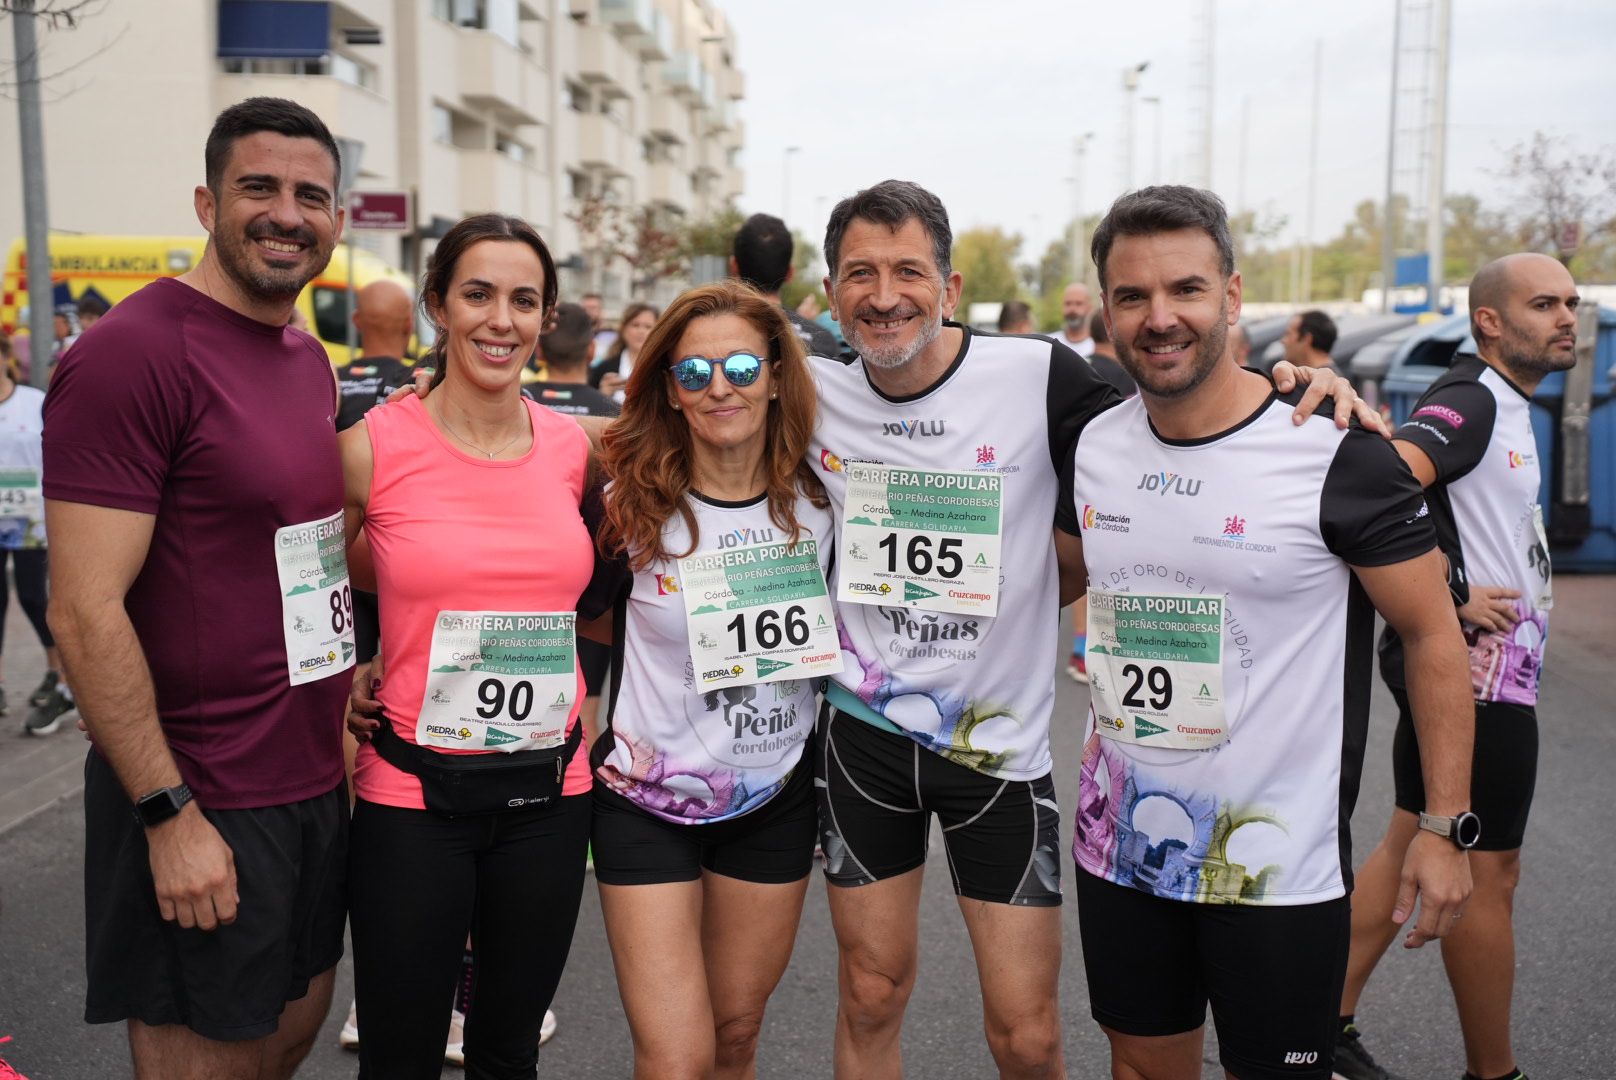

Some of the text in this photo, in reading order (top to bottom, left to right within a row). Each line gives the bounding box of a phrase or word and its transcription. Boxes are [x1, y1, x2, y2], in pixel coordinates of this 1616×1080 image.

[883, 419, 945, 440] JOYLU
[851, 468, 999, 492] CARRERA POPULAR
[1137, 471, 1201, 497] JOYLU
[905, 492, 935, 505] PEÑAS
[937, 496, 999, 508] CORDOBESAS
[862, 503, 902, 516] Córdoba
[910, 508, 944, 519] Medina
[947, 511, 987, 522] Azahara
[1095, 511, 1130, 525] Diputación
[280, 523, 334, 547] CARRERA
[884, 519, 968, 533] CARRERA SOLIDARIA
[1094, 522, 1130, 533] de Córdoba
[718, 528, 774, 549] JOYLU
[1192, 535, 1235, 550] AYUNTAMIENTO
[1235, 541, 1245, 550] DE
[683, 543, 816, 573] CARRERA POPULAR
[879, 532, 963, 579] 165
[745, 567, 773, 580] PEÑAS
[775, 562, 820, 576] CORDOBESAS
[1110, 567, 1129, 585] DE
[1134, 564, 1168, 578] ORO
[1175, 570, 1196, 589] DE
[704, 587, 744, 600] Córdoba
[753, 582, 785, 593] Medina
[787, 577, 817, 588] Azahara
[948, 589, 991, 601] Cruzcampo
[729, 591, 806, 608] CARRERA SOLIDARIA
[1089, 594, 1219, 615] CARRERA POPULAR
[330, 585, 353, 634] 89
[440, 615, 572, 631] CARRERA POPULAR
[727, 605, 810, 652] 166
[890, 611, 979, 643] Peñas
[1130, 618, 1157, 630] PEÑAS
[1159, 621, 1220, 633] CORDOBESAS
[499, 637, 526, 648] PEÑAS
[528, 638, 574, 648] CORDOBESAS
[1135, 637, 1168, 647] Medina
[1170, 639, 1207, 649] Azahara
[452, 651, 493, 661] Córdoba
[502, 653, 534, 662] Medina
[536, 653, 566, 661] Azahara
[801, 653, 836, 664] Cruzcampo
[1114, 648, 1189, 661] CARRERA SOLIDARIA
[473, 664, 552, 674] CARRERA SOLIDARIA
[1122, 664, 1173, 711] 29
[476, 678, 534, 722] 90
[733, 703, 797, 739] Peñas
[1177, 724, 1221, 736] Cruzcampo
[530, 728, 561, 739] Cruzcampo
